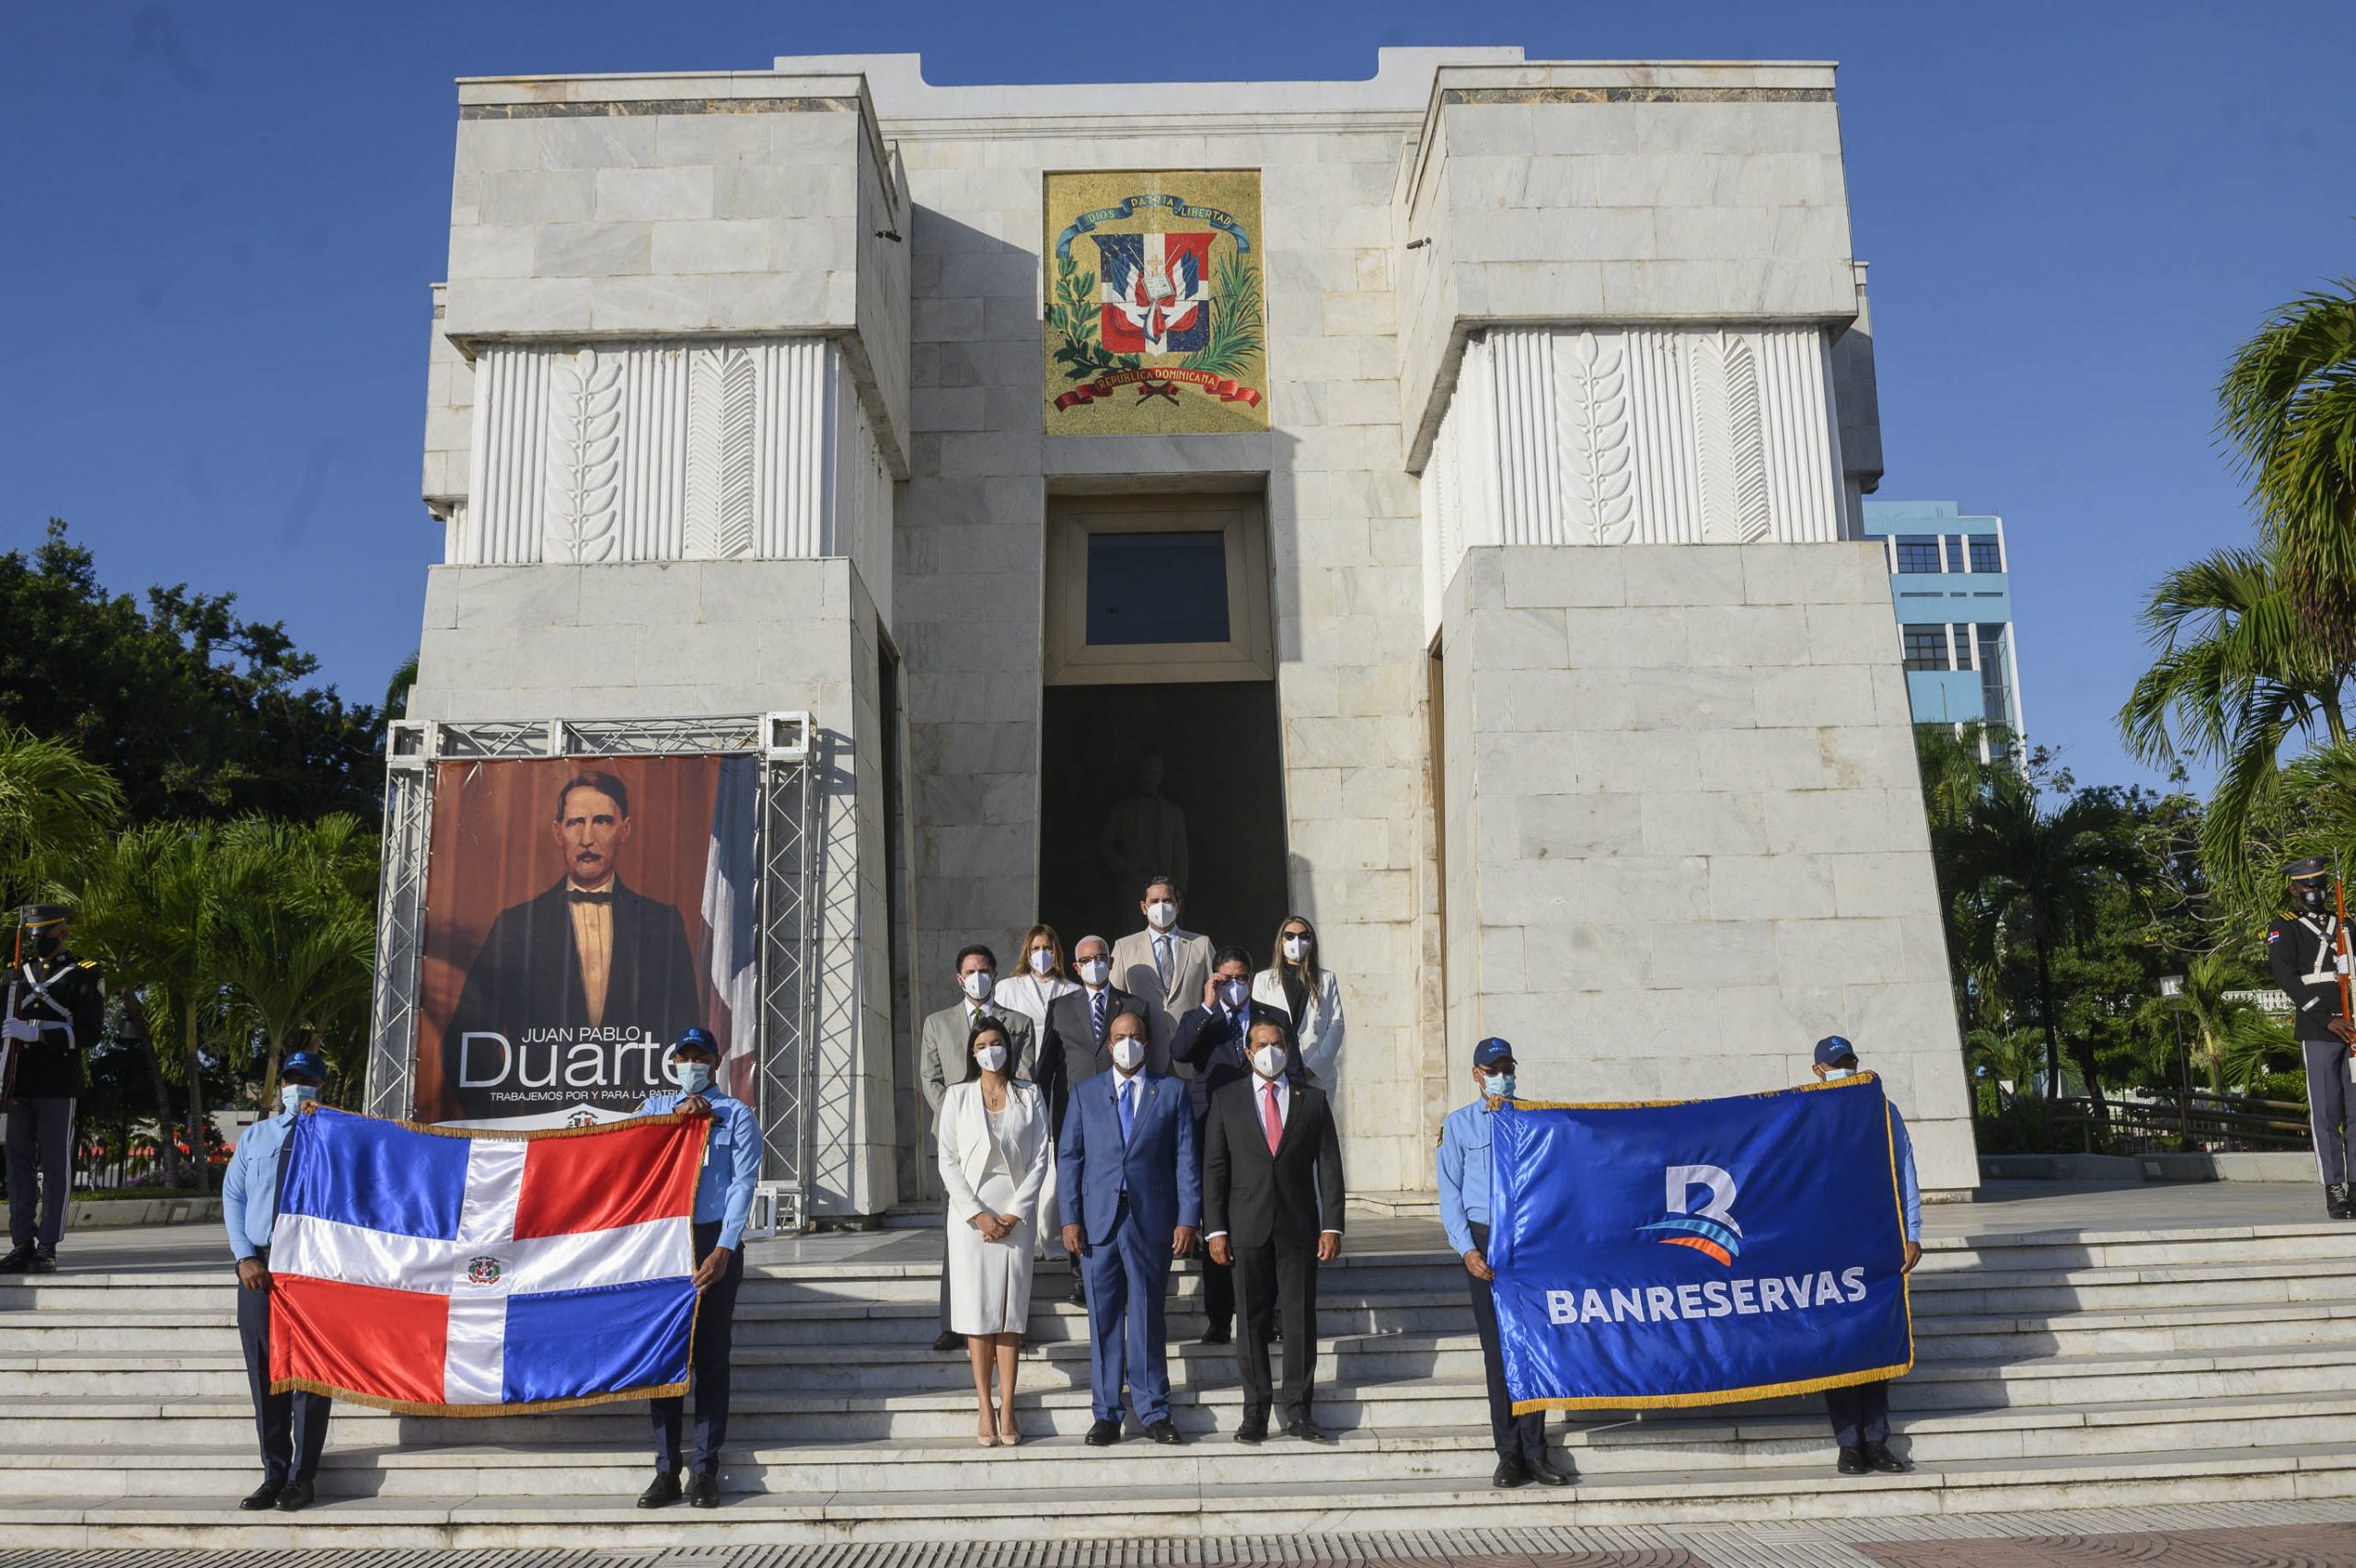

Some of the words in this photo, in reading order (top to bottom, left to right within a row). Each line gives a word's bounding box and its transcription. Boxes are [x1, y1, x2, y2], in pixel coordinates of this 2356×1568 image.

[1088, 209, 1115, 224] DIOS
[1130, 196, 1174, 208] PATRIA
[1181, 207, 1231, 225] LIBERTAD
[1098, 370, 1154, 389] REPUBLICA
[1155, 369, 1215, 386] DOMINICANA
[521, 1027, 572, 1043] JUAN
[579, 1025, 641, 1043] PABLO
[490, 1091, 563, 1101] TRABAJEMOS
[565, 1090, 589, 1101] POR
[591, 1090, 599, 1100] Y
[601, 1090, 629, 1100] PARA
[632, 1090, 647, 1100] LA
[649, 1089, 681, 1098] PATRI
[1545, 1266, 1867, 1326] BANRESERVAS
